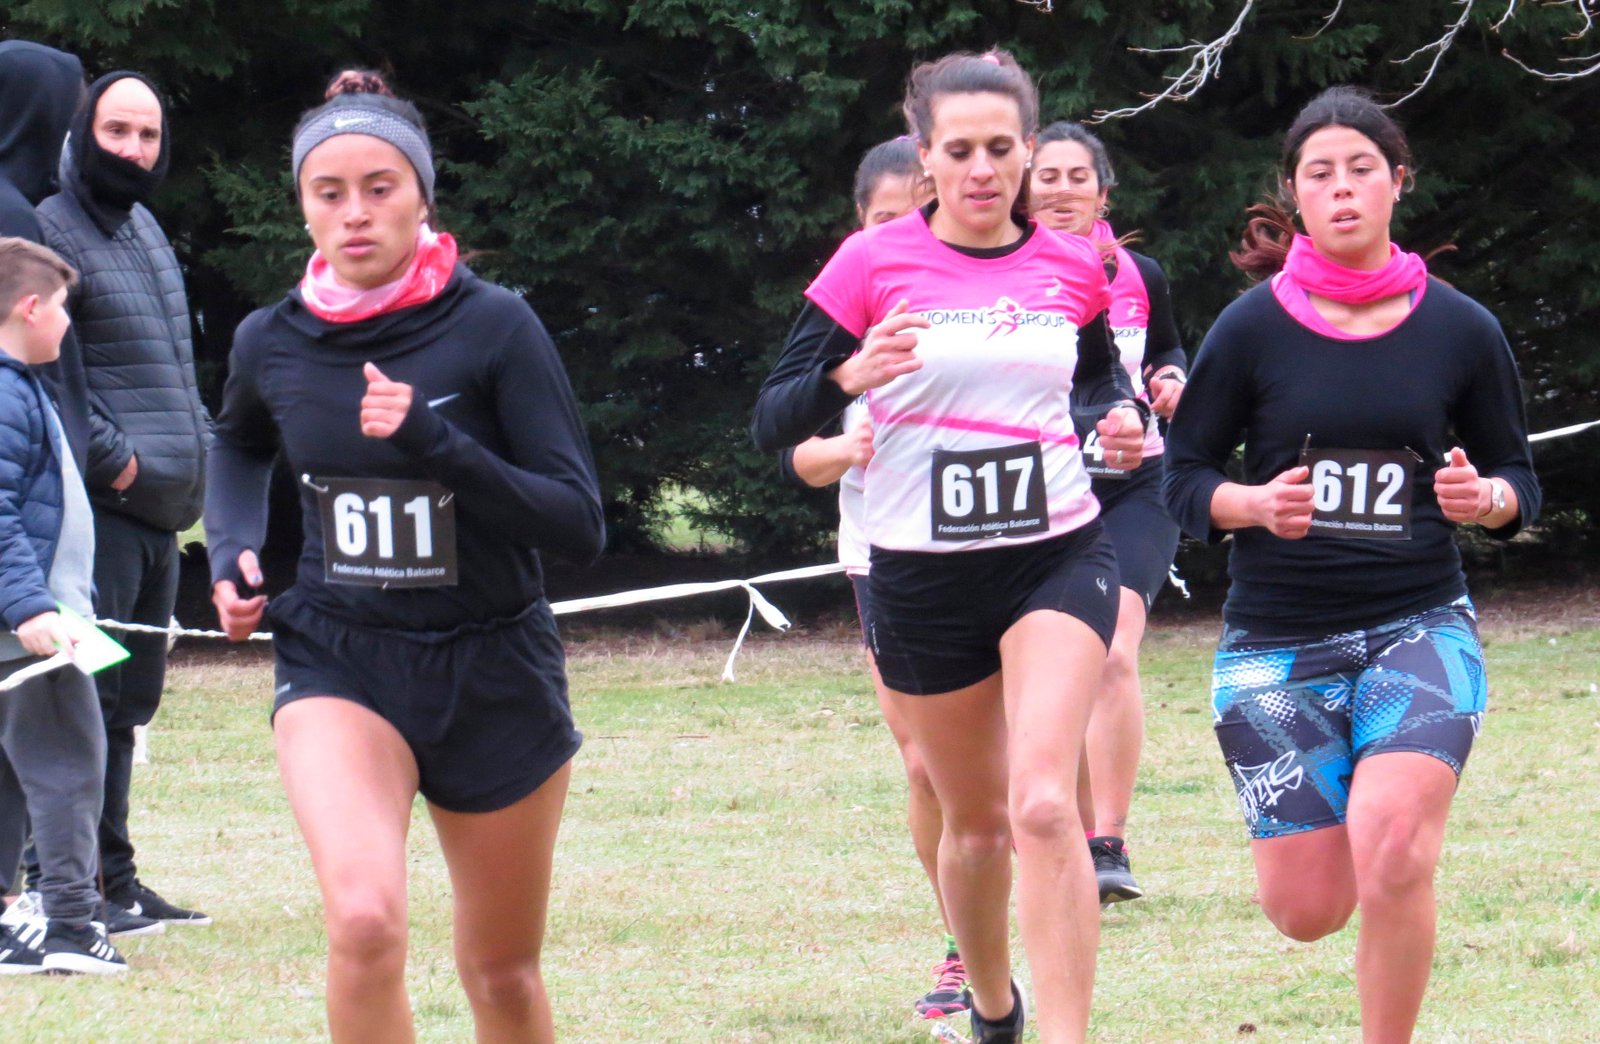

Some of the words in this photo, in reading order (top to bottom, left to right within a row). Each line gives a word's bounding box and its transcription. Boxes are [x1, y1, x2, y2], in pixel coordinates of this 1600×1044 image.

[1013, 313, 1065, 328] GROUP
[1115, 328, 1140, 338] ROUP
[942, 455, 1034, 517] 617
[1312, 460, 1405, 515] 612
[334, 493, 432, 558] 611
[938, 523, 980, 533] Federación
[980, 521, 1009, 531] Atlética
[1009, 518, 1040, 528] Balcarce
[332, 562, 374, 576] Federación
[374, 566, 405, 578] Atlética
[406, 567, 446, 578] Balcarce
